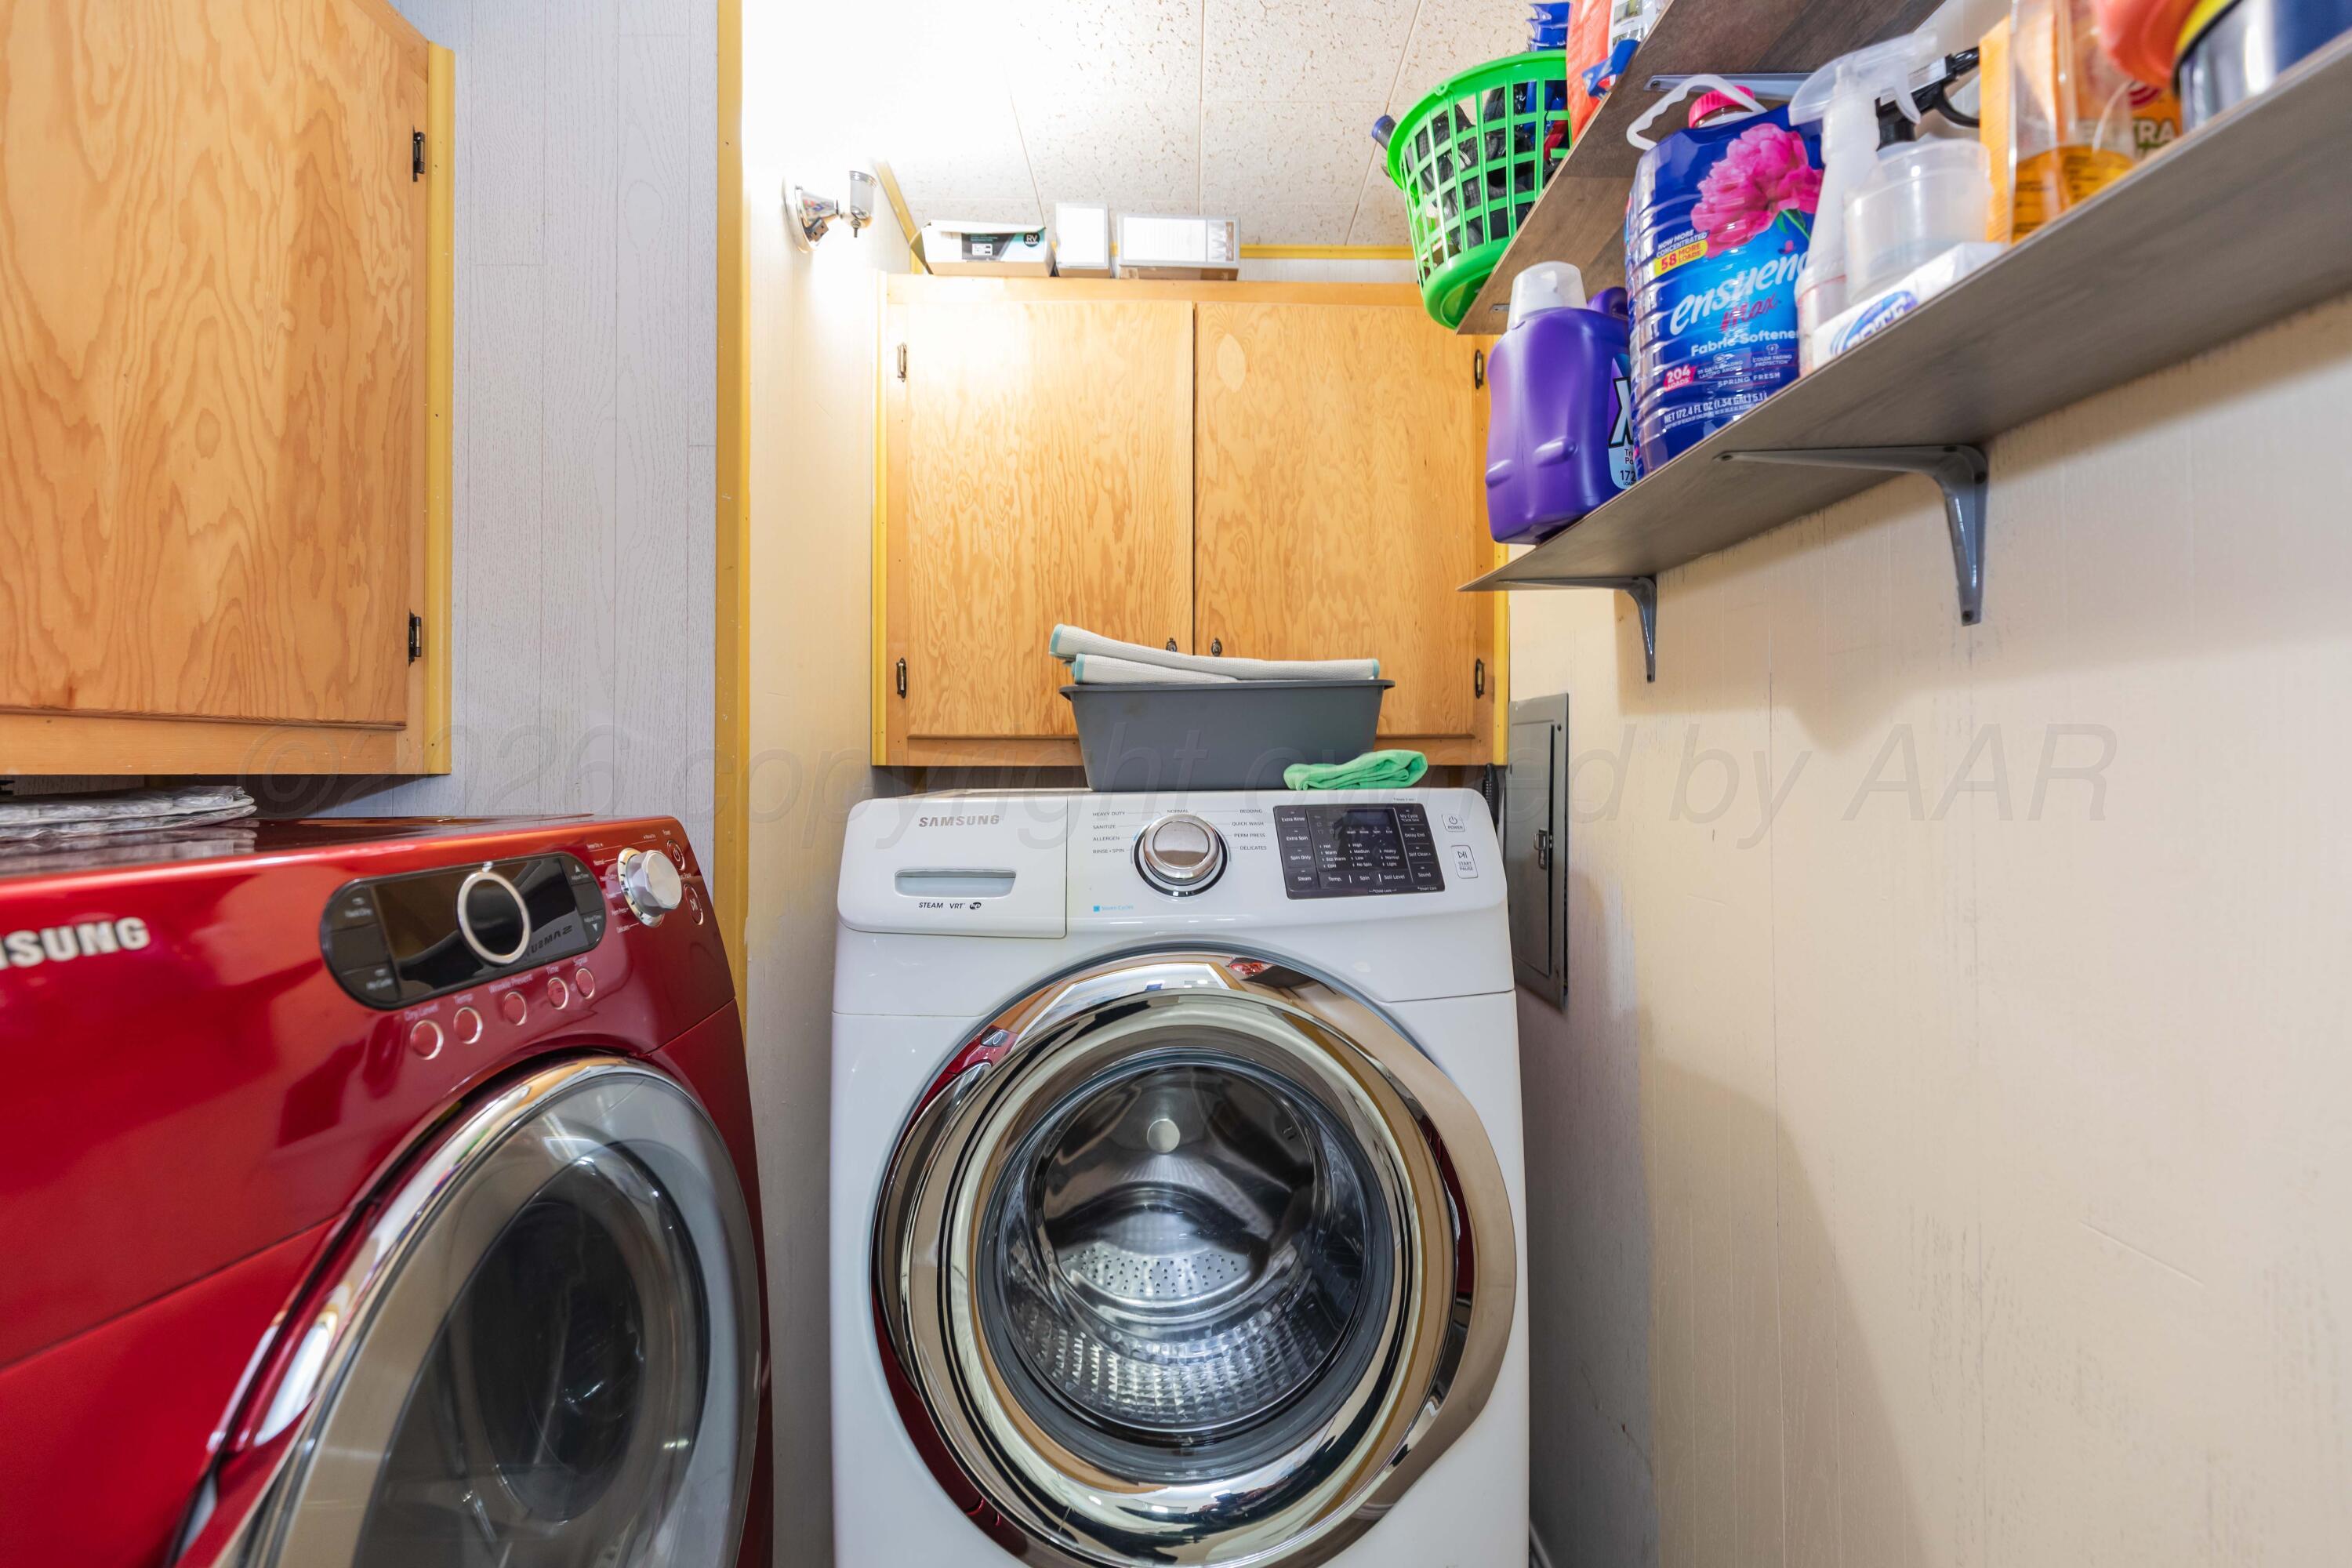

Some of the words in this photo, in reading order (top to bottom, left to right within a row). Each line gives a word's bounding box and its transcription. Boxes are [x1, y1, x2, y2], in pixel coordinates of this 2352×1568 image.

[1656, 232, 1708, 258] CONCENTRATED
[1658, 237, 1674, 249] NOW
[1673, 230, 1695, 243] MORE
[1679, 243, 1701, 256] MORE
[1661, 253, 1677, 271] 58
[1691, 337, 1736, 357] Fabric
[1667, 366, 1691, 383] 204
[1667, 376, 1690, 390] LOADS
[1718, 376, 1751, 388] SPRING
[1753, 372, 1780, 381] FRESH
[1664, 412, 1675, 424] NET
[1676, 407, 1693, 421] 172.4
[1693, 404, 1702, 414] FL
[1703, 401, 1713, 412] OZ
[918, 815, 1000, 828] SAMSUNG
[0, 916, 151, 971] SUNG
[546, 965, 559, 974] Time
